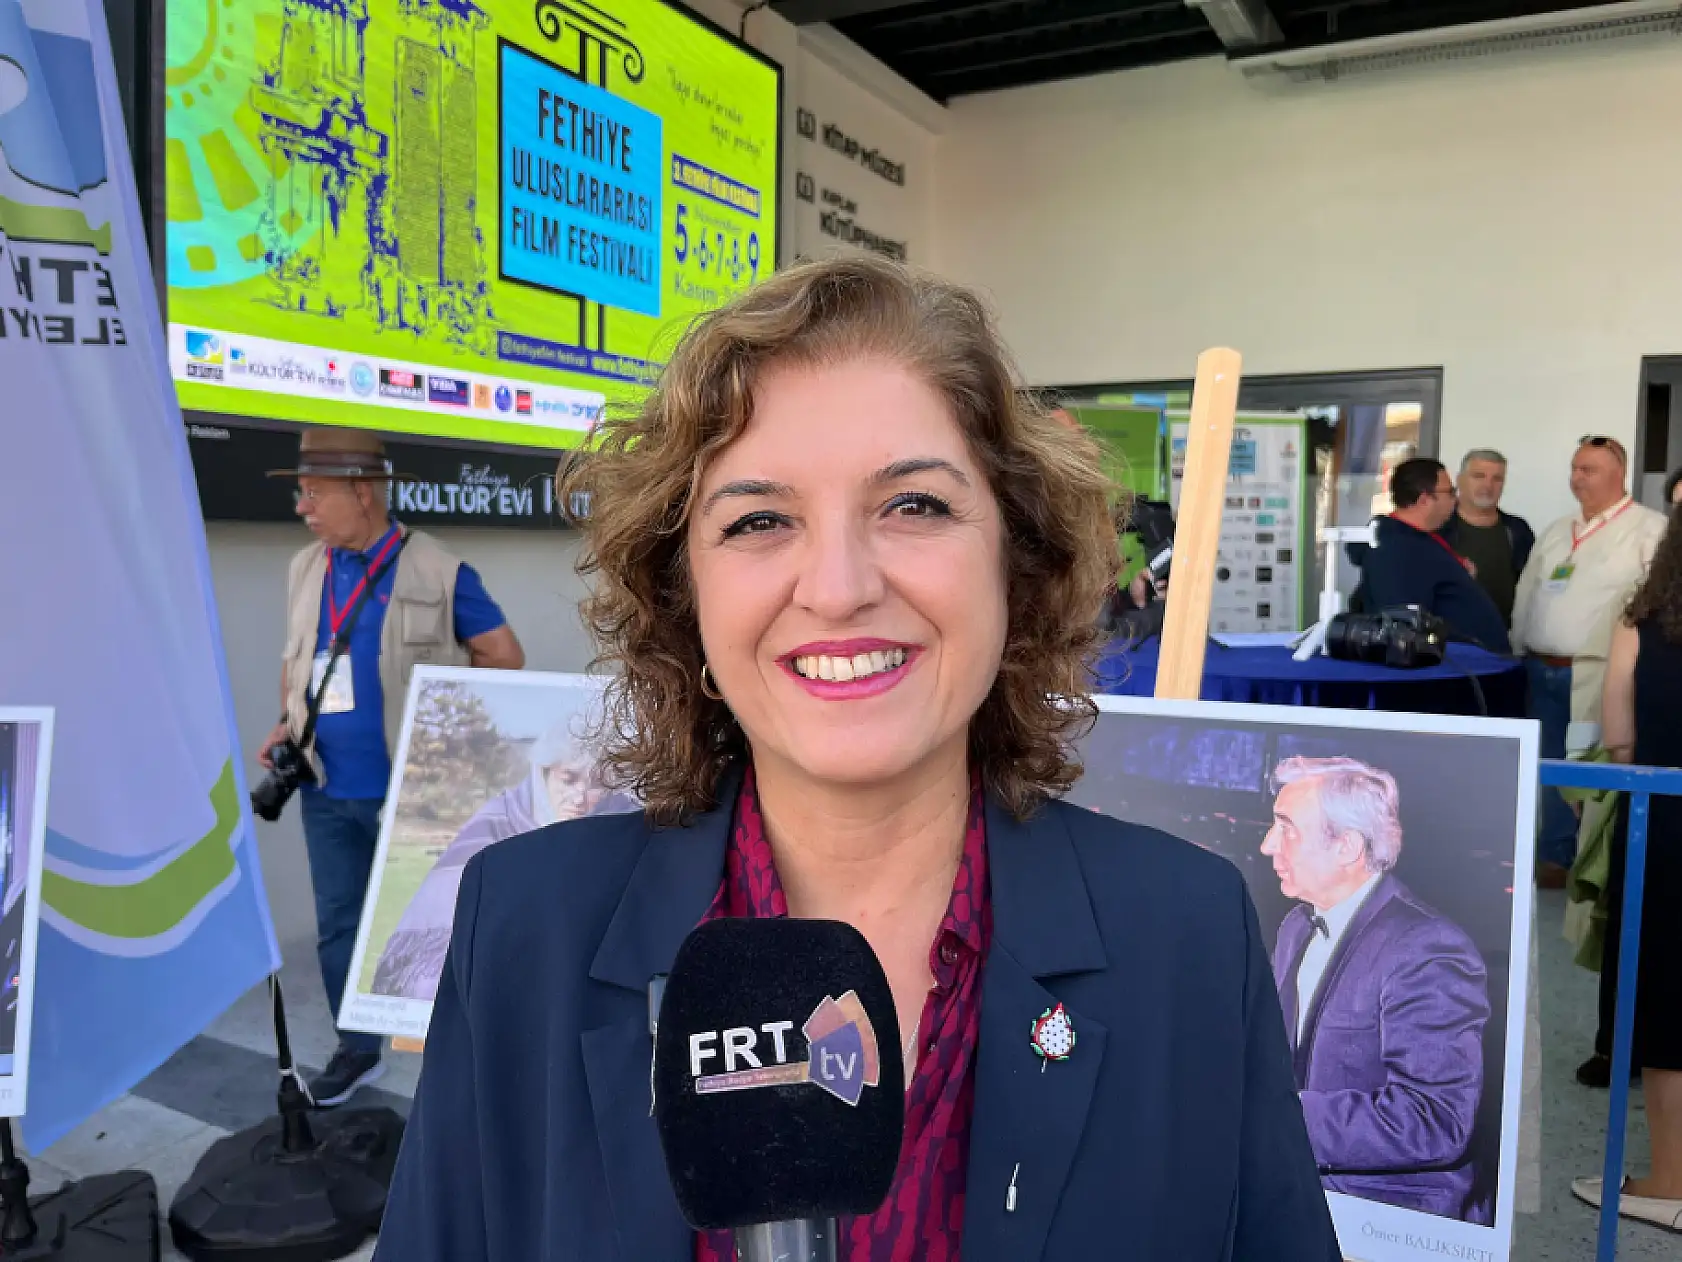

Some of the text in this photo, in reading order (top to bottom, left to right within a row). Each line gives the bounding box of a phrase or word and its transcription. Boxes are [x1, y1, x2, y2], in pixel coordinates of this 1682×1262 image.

[538, 87, 631, 172] FETHİYE
[512, 146, 653, 233] ULUSLARARASI
[397, 479, 492, 515] KÜLTÜR
[689, 1020, 793, 1077] FRT
[820, 1046, 858, 1081] tv
[1360, 1219, 1400, 1244] Ömer
